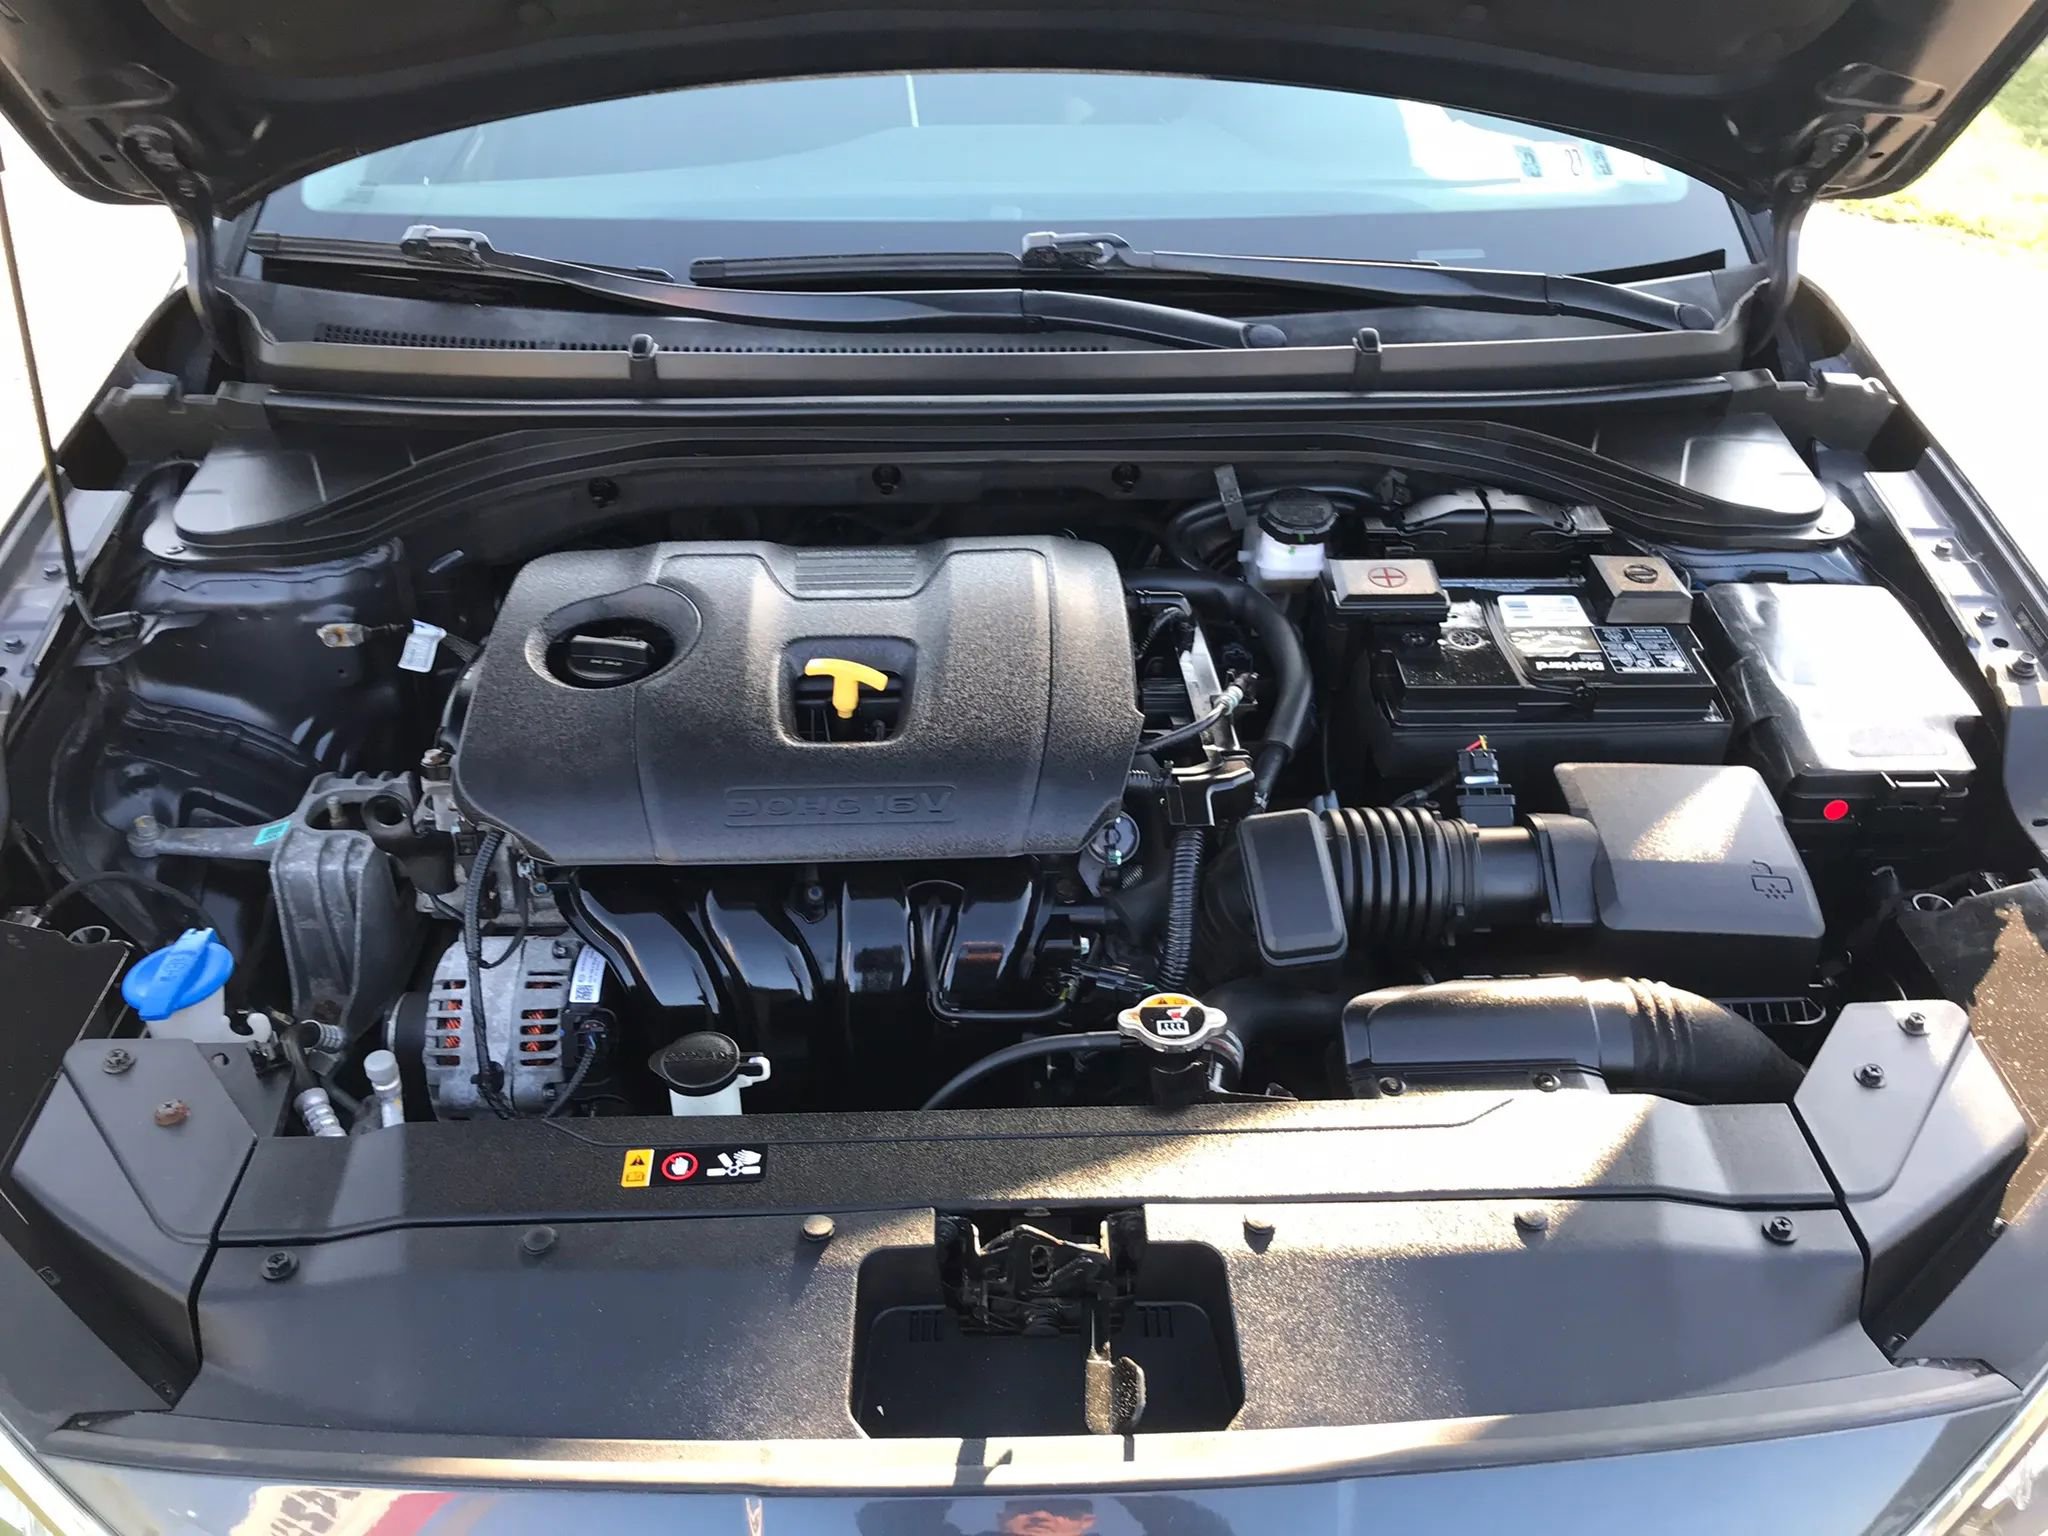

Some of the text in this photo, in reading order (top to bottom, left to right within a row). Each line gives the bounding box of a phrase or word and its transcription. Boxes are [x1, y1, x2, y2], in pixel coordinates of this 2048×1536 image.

[1535, 660, 1605, 672] DieHard
[727, 790, 952, 817] DOHC 16V
